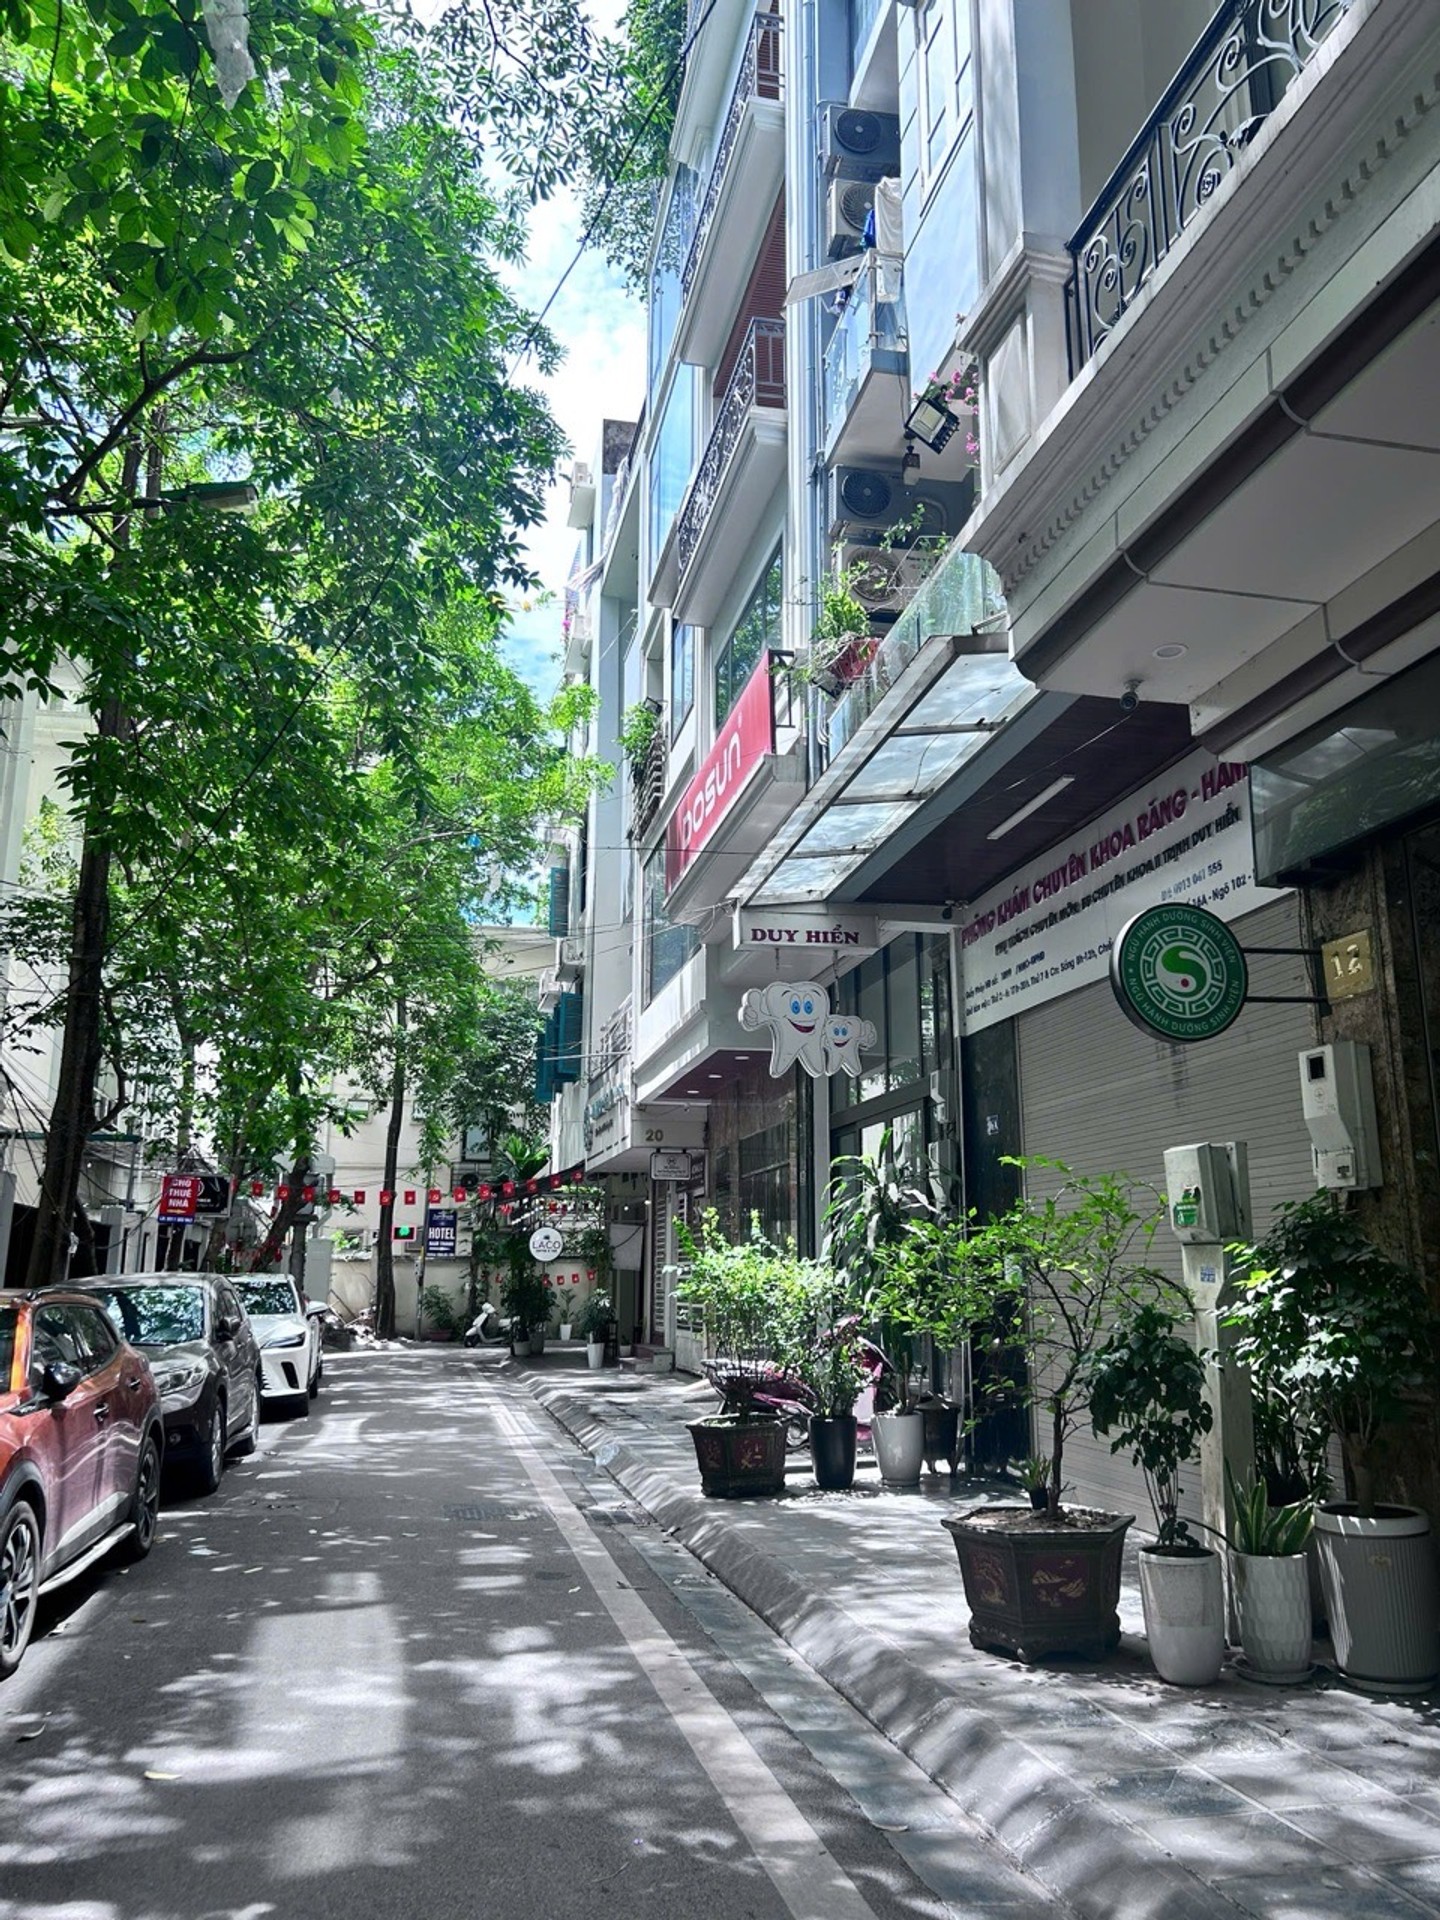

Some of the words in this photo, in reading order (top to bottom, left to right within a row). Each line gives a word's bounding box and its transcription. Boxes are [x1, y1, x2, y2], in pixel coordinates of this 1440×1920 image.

[997, 886, 1030, 926] KHÁM
[1033, 853, 1088, 904] CHUYÊN
[1089, 823, 1136, 871] KHOA
[1137, 789, 1187, 842] RĂNG
[1127, 859, 1155, 884] KHOA
[1191, 824, 1214, 847] DUY
[751, 928, 798, 942] DUY
[1200, 919, 1222, 940] SINH
[1209, 1005, 1231, 1024] SINH
[645, 1129, 664, 1141] 20
[428, 1227, 456, 1240] HOTEL
[532, 1240, 561, 1249] LACO
